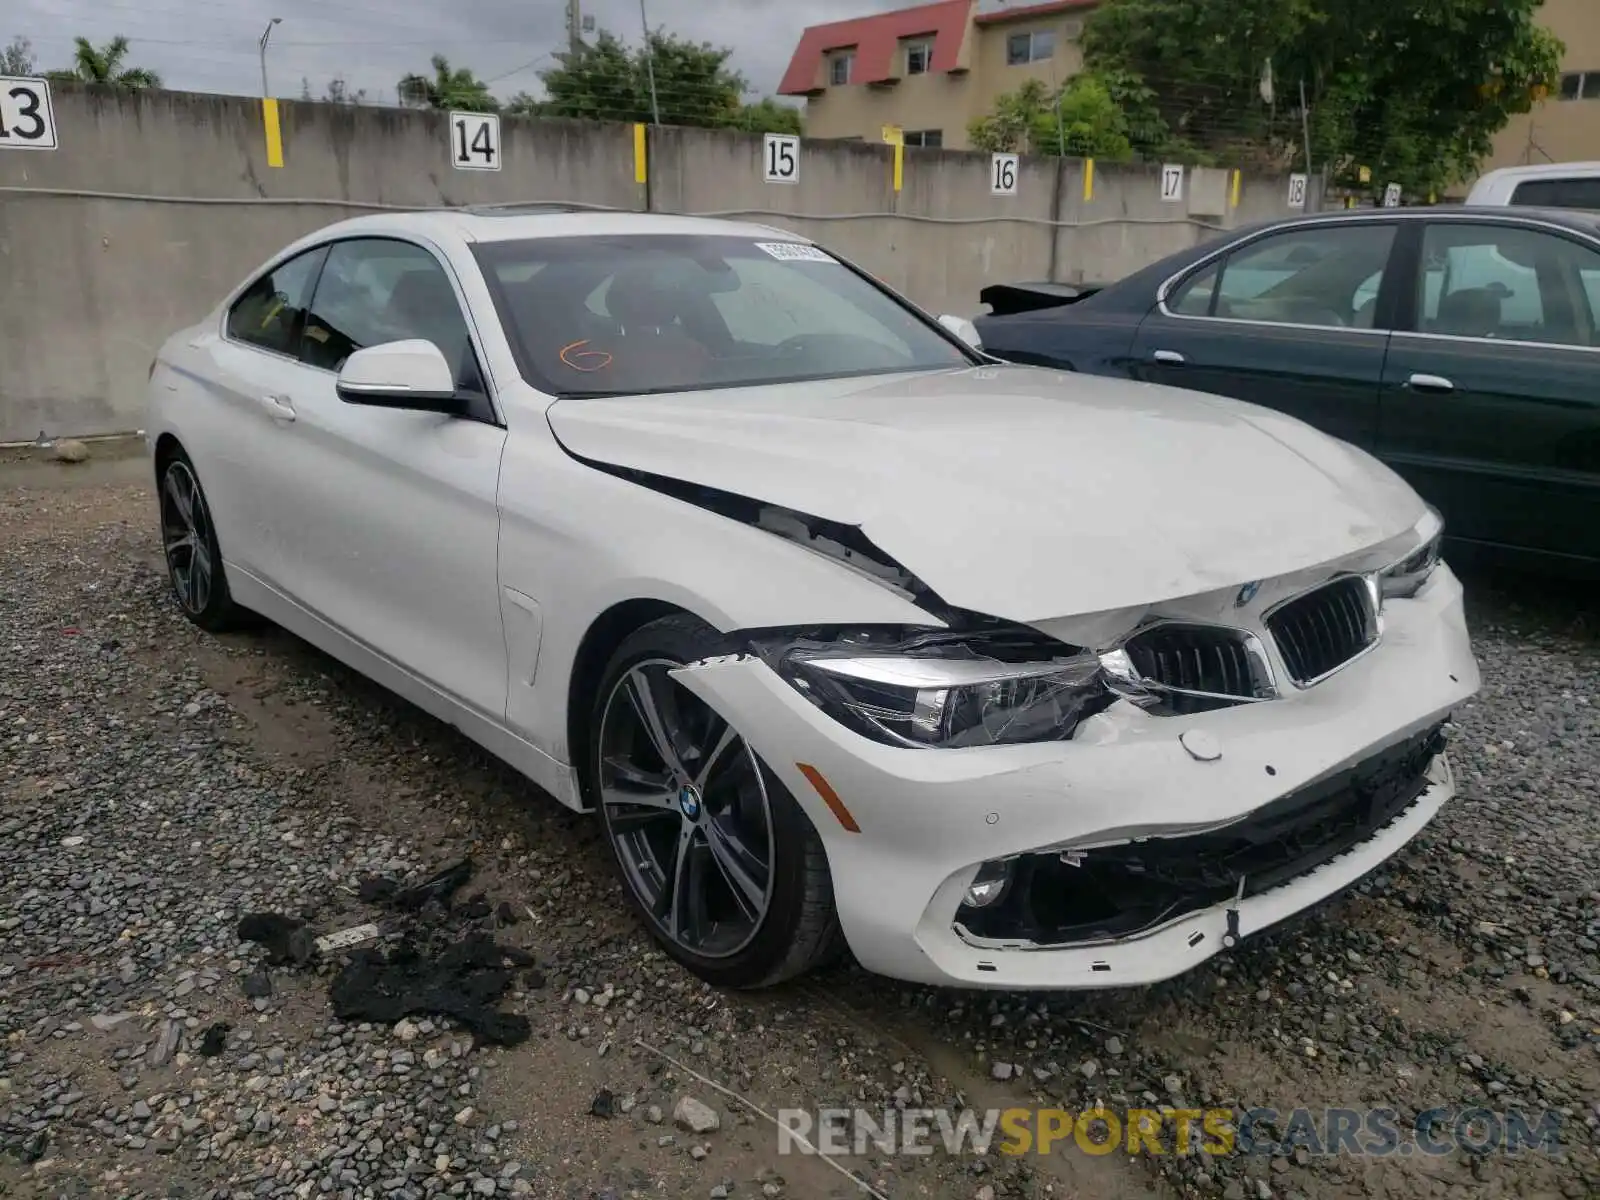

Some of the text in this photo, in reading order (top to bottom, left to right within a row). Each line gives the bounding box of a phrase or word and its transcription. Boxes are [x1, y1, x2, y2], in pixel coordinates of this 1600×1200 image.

[455, 120, 495, 163] 14
[768, 140, 794, 177] 15
[994, 160, 1014, 189] 16
[1164, 170, 1180, 196] 17
[1290, 179, 1304, 203] 18
